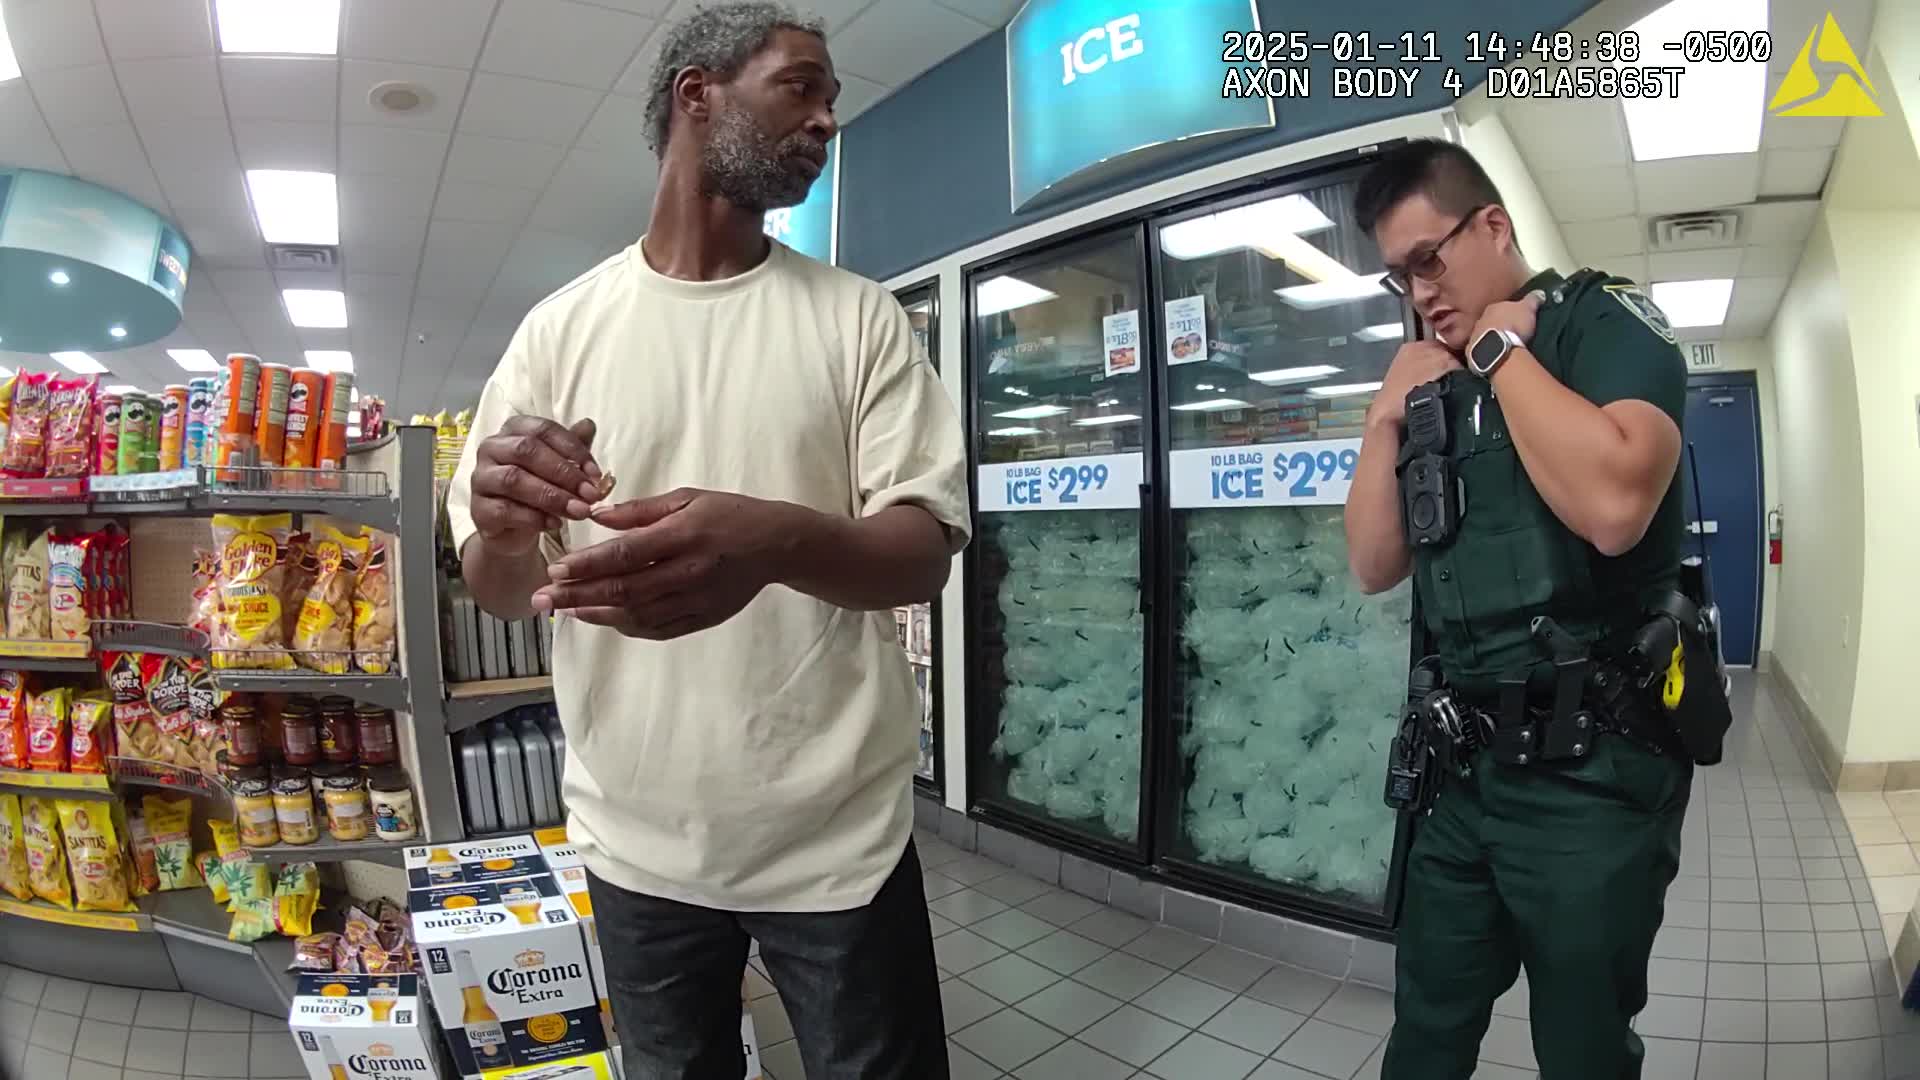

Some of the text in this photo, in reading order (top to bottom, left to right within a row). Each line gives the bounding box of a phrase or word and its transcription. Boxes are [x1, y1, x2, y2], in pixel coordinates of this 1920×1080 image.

[1060, 13, 1144, 86] ICE
[1692, 344, 1716, 365] EXIT
[1211, 452, 1263, 466] 10 LB BAG
[1006, 466, 1042, 478] 10 LB BAG
[1006, 478, 1042, 504] ICE
[1211, 467, 1264, 499] ICE
[225, 540, 273, 560] Golden
[229, 554, 271, 580] Flke
[152, 683, 188, 700] BORDE
[68, 833, 107, 850] SANTITAS
[458, 842, 528, 857] Corona
[424, 911, 506, 930] Corona
[431, 950, 446, 962] 12
[487, 962, 583, 995] Corona
[511, 988, 565, 1004] Extra
[300, 1003, 365, 1017] Corona
[302, 1032, 313, 1043] 12
[348, 1054, 427, 1075] Corona
